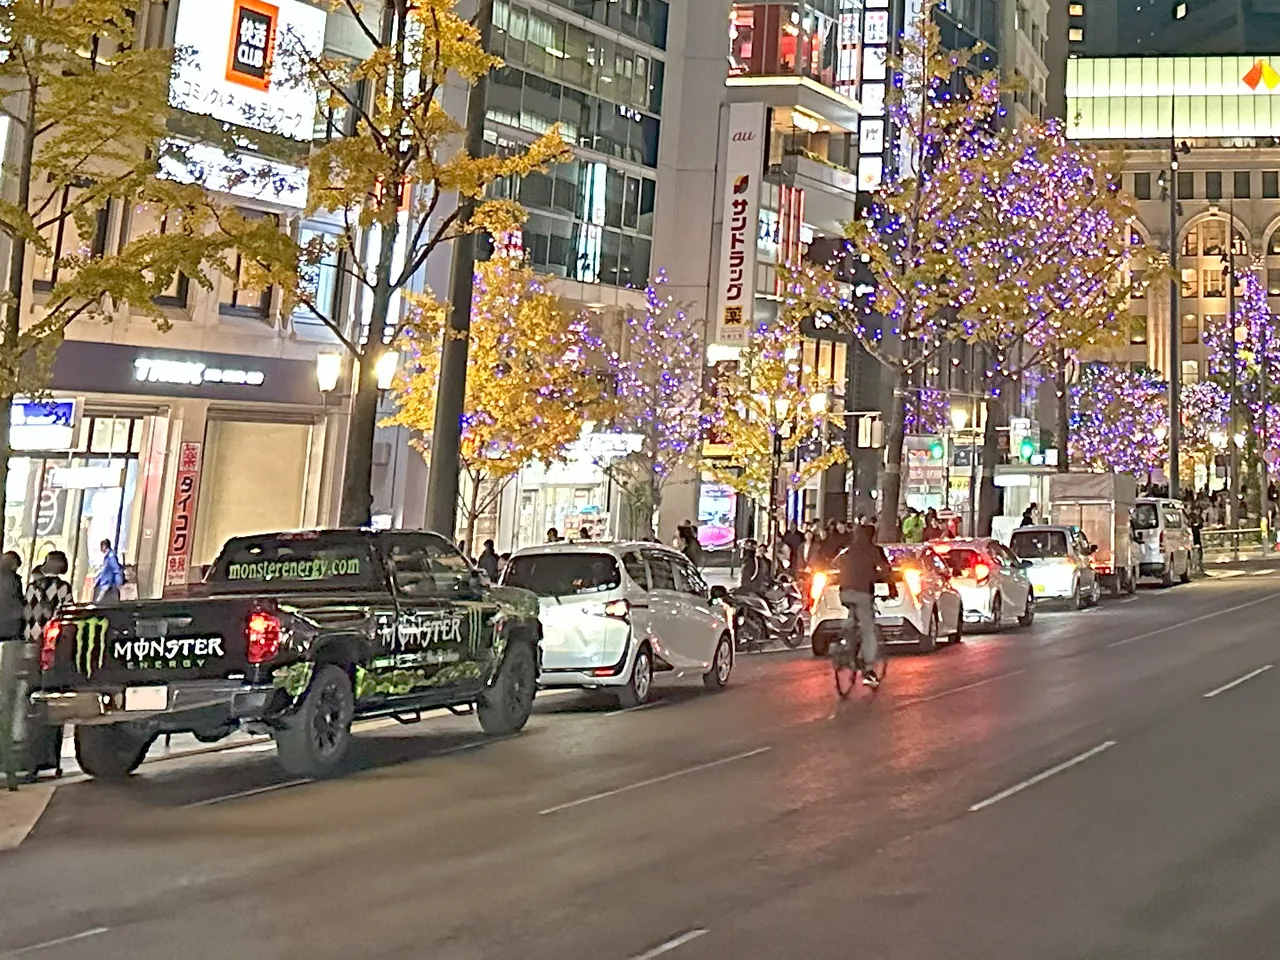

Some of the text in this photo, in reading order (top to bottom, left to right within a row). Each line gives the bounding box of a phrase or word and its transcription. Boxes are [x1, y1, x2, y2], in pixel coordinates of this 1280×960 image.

[732, 130, 755, 142] au
[727, 199, 748, 302] サンドラッグ
[725, 306, 742, 325] 薬
[228, 557, 361, 581] monsterenergy.com
[114, 637, 224, 659] MONSTER
[126, 659, 206, 669] ENERGY
